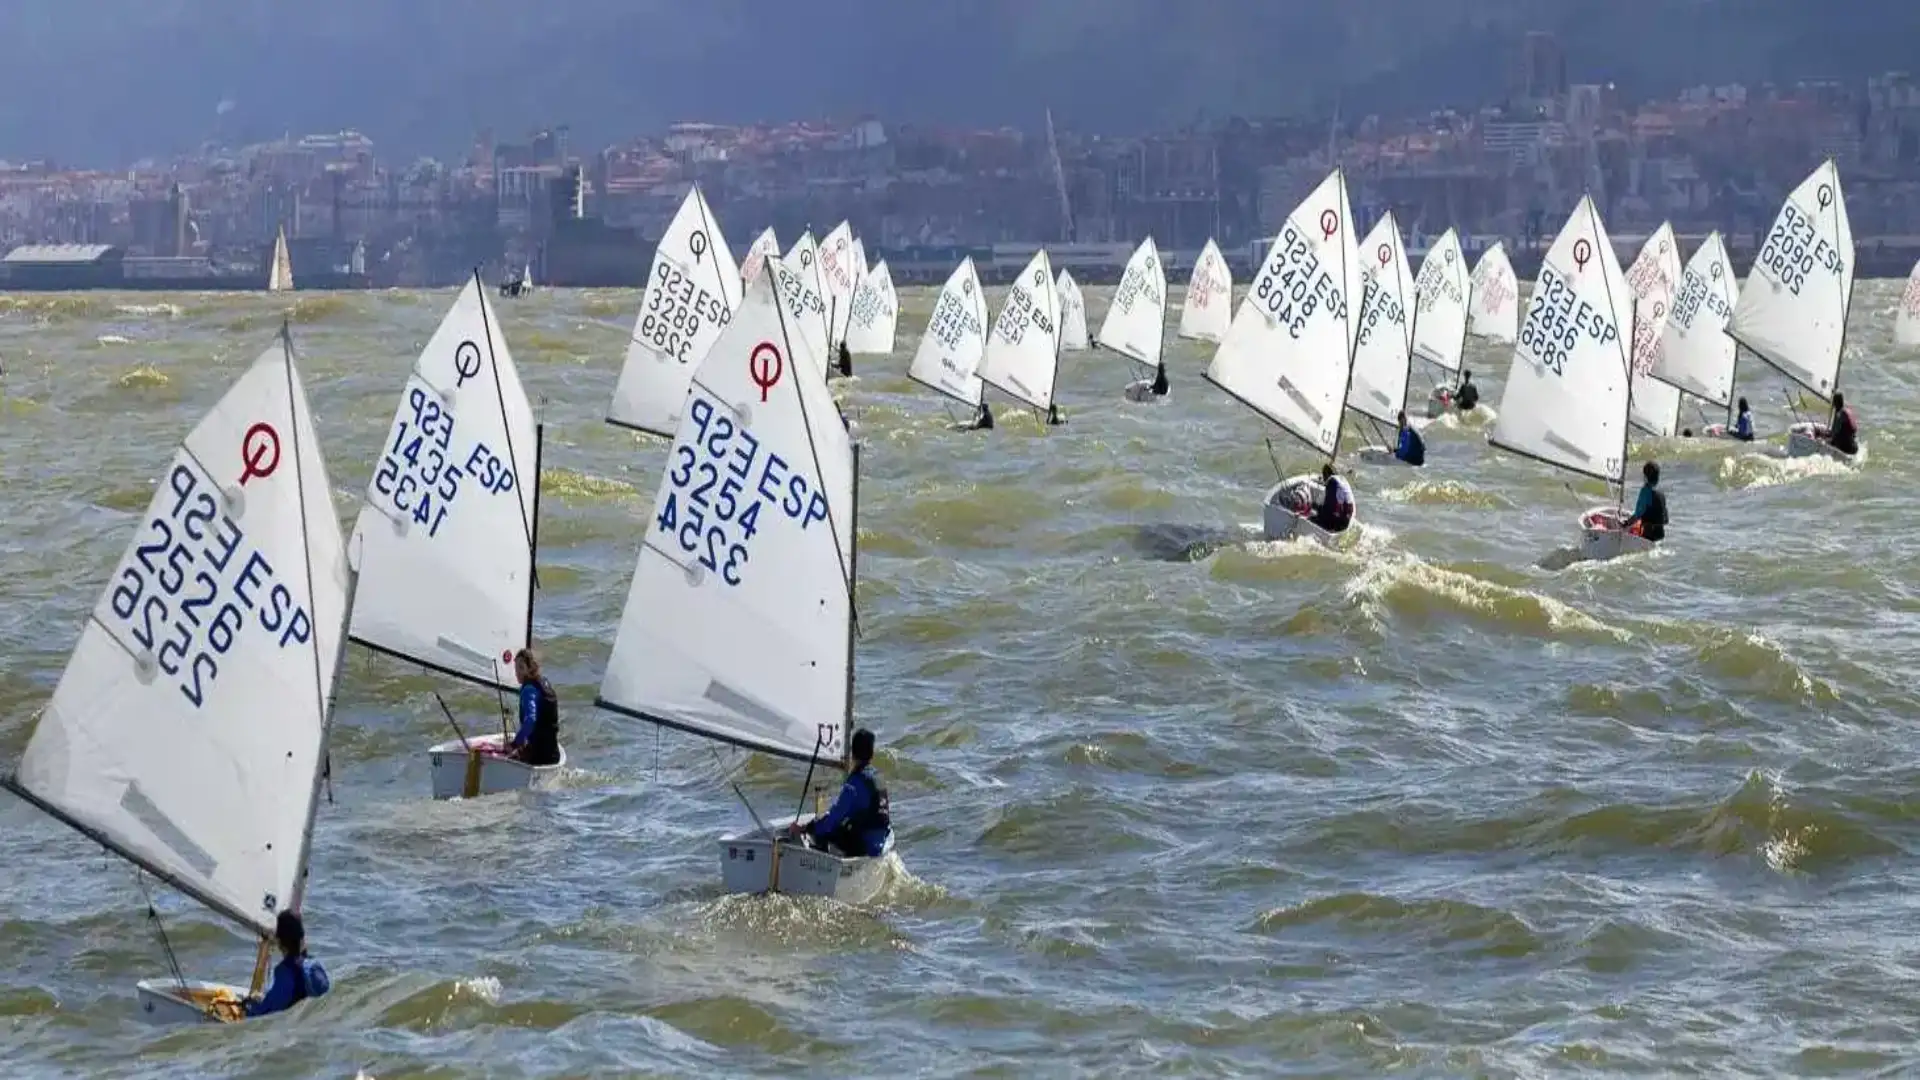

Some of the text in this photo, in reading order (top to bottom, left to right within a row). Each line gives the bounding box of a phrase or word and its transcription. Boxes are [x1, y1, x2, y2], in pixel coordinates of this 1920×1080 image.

[1770, 225, 1813, 274] 2090
[695, 290, 731, 329] ESP
[1270, 252, 1317, 316] 3408
[1316, 272, 1347, 321] ESP
[1377, 292, 1405, 325] ESP
[649, 288, 699, 337] 3289
[1031, 308, 1054, 335] ESP
[1530, 297, 1579, 351] 2856
[1576, 300, 1617, 345] ESP
[392, 422, 463, 503] 1435
[464, 442, 514, 496] ESP
[670, 445, 762, 540] 3254
[757, 453, 828, 529] ESP
[137, 518, 243, 654] 2526
[233, 551, 311, 648] ESP
